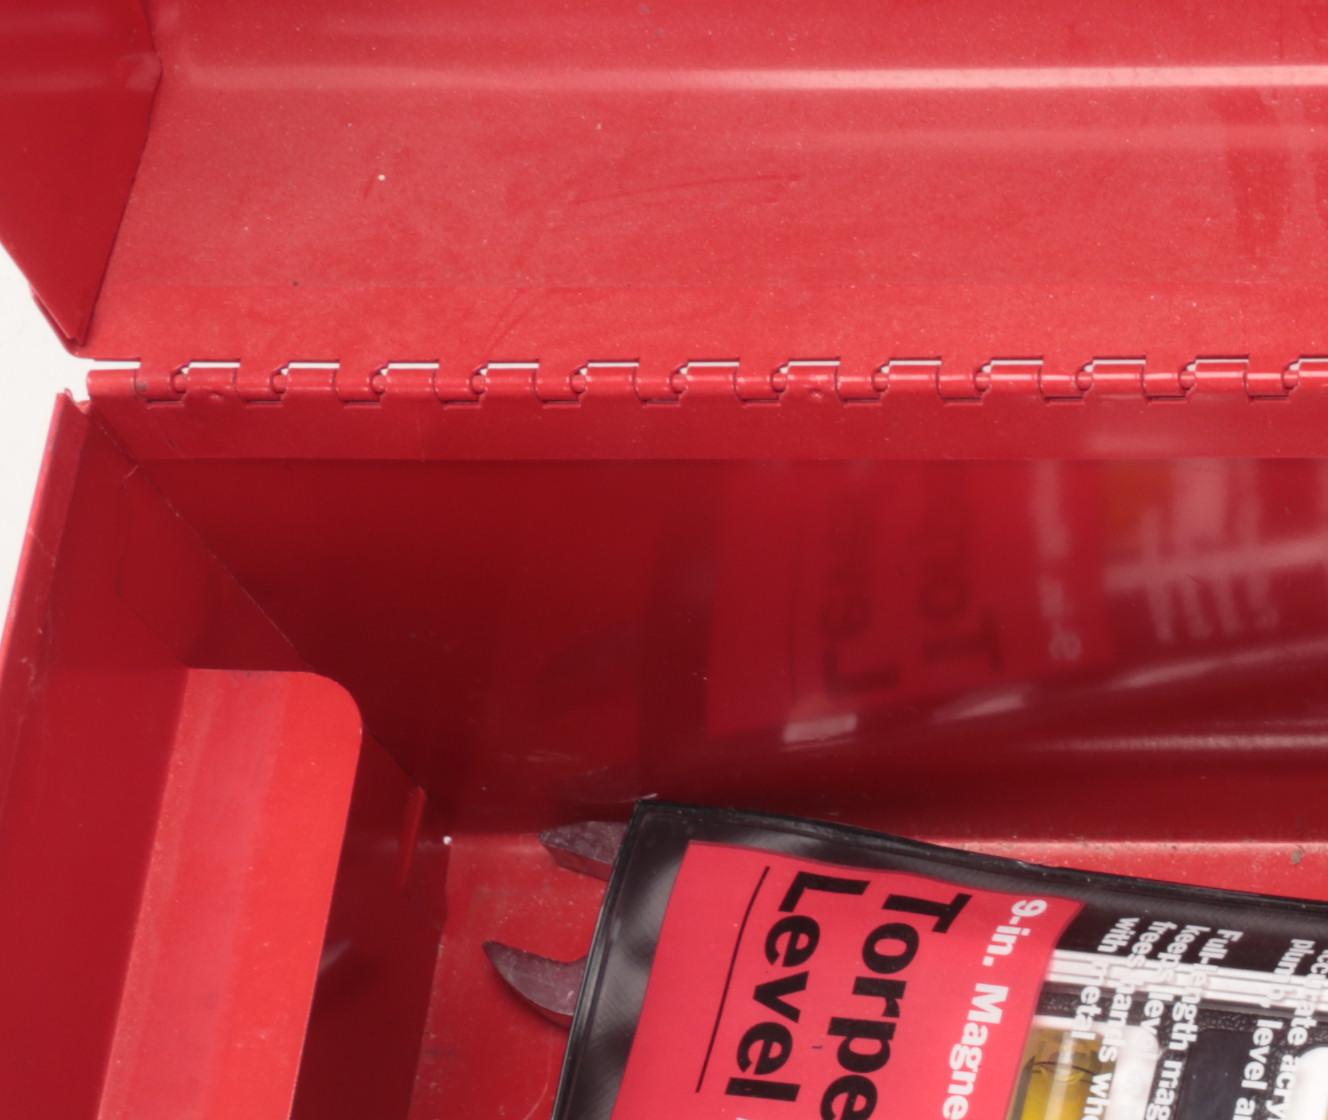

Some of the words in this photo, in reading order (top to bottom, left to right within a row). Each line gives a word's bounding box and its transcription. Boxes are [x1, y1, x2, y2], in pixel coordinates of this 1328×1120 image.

[980, 899, 1048, 968] 9-in.
[1097, 917, 1140, 953] with
[1126, 921, 1177, 967] frees
[724, 870, 871, 1102] Level
[1135, 991, 1175, 1058] lev
[1241, 1019, 1284, 1090] level
